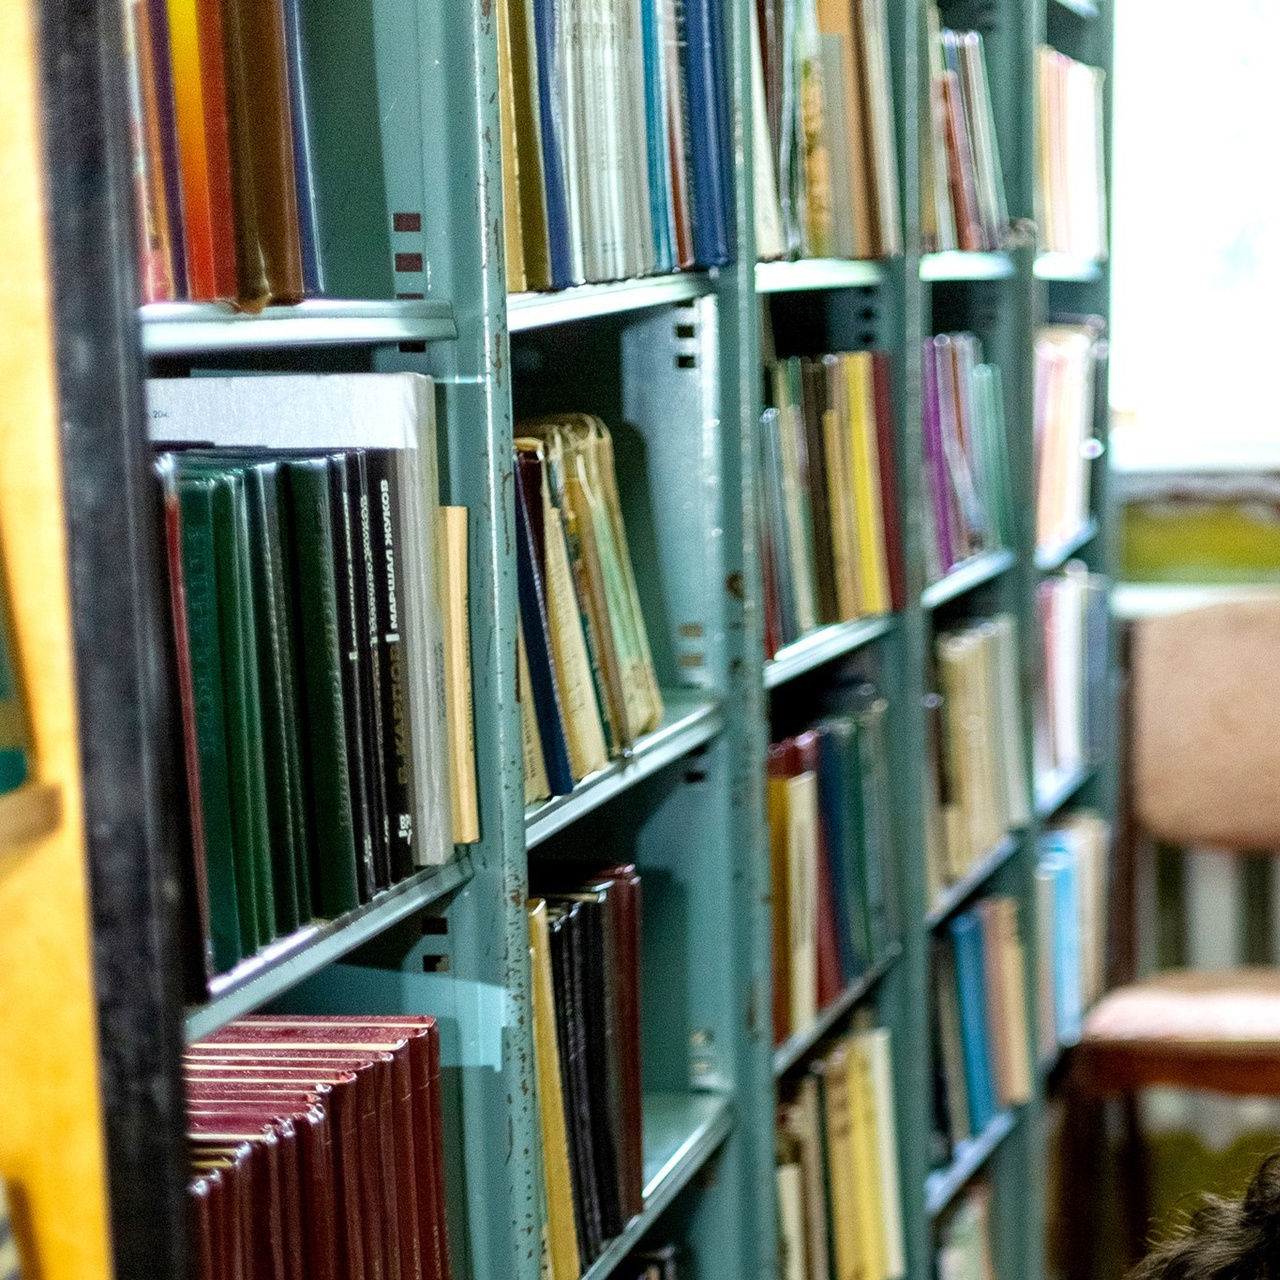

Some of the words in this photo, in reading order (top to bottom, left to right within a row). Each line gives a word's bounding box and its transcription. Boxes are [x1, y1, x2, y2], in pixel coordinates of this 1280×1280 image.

[379, 479, 394, 545] ЖУКОВ
[383, 548, 401, 630] МАРШАЛ
[387, 644, 409, 756] КАРПОВ
